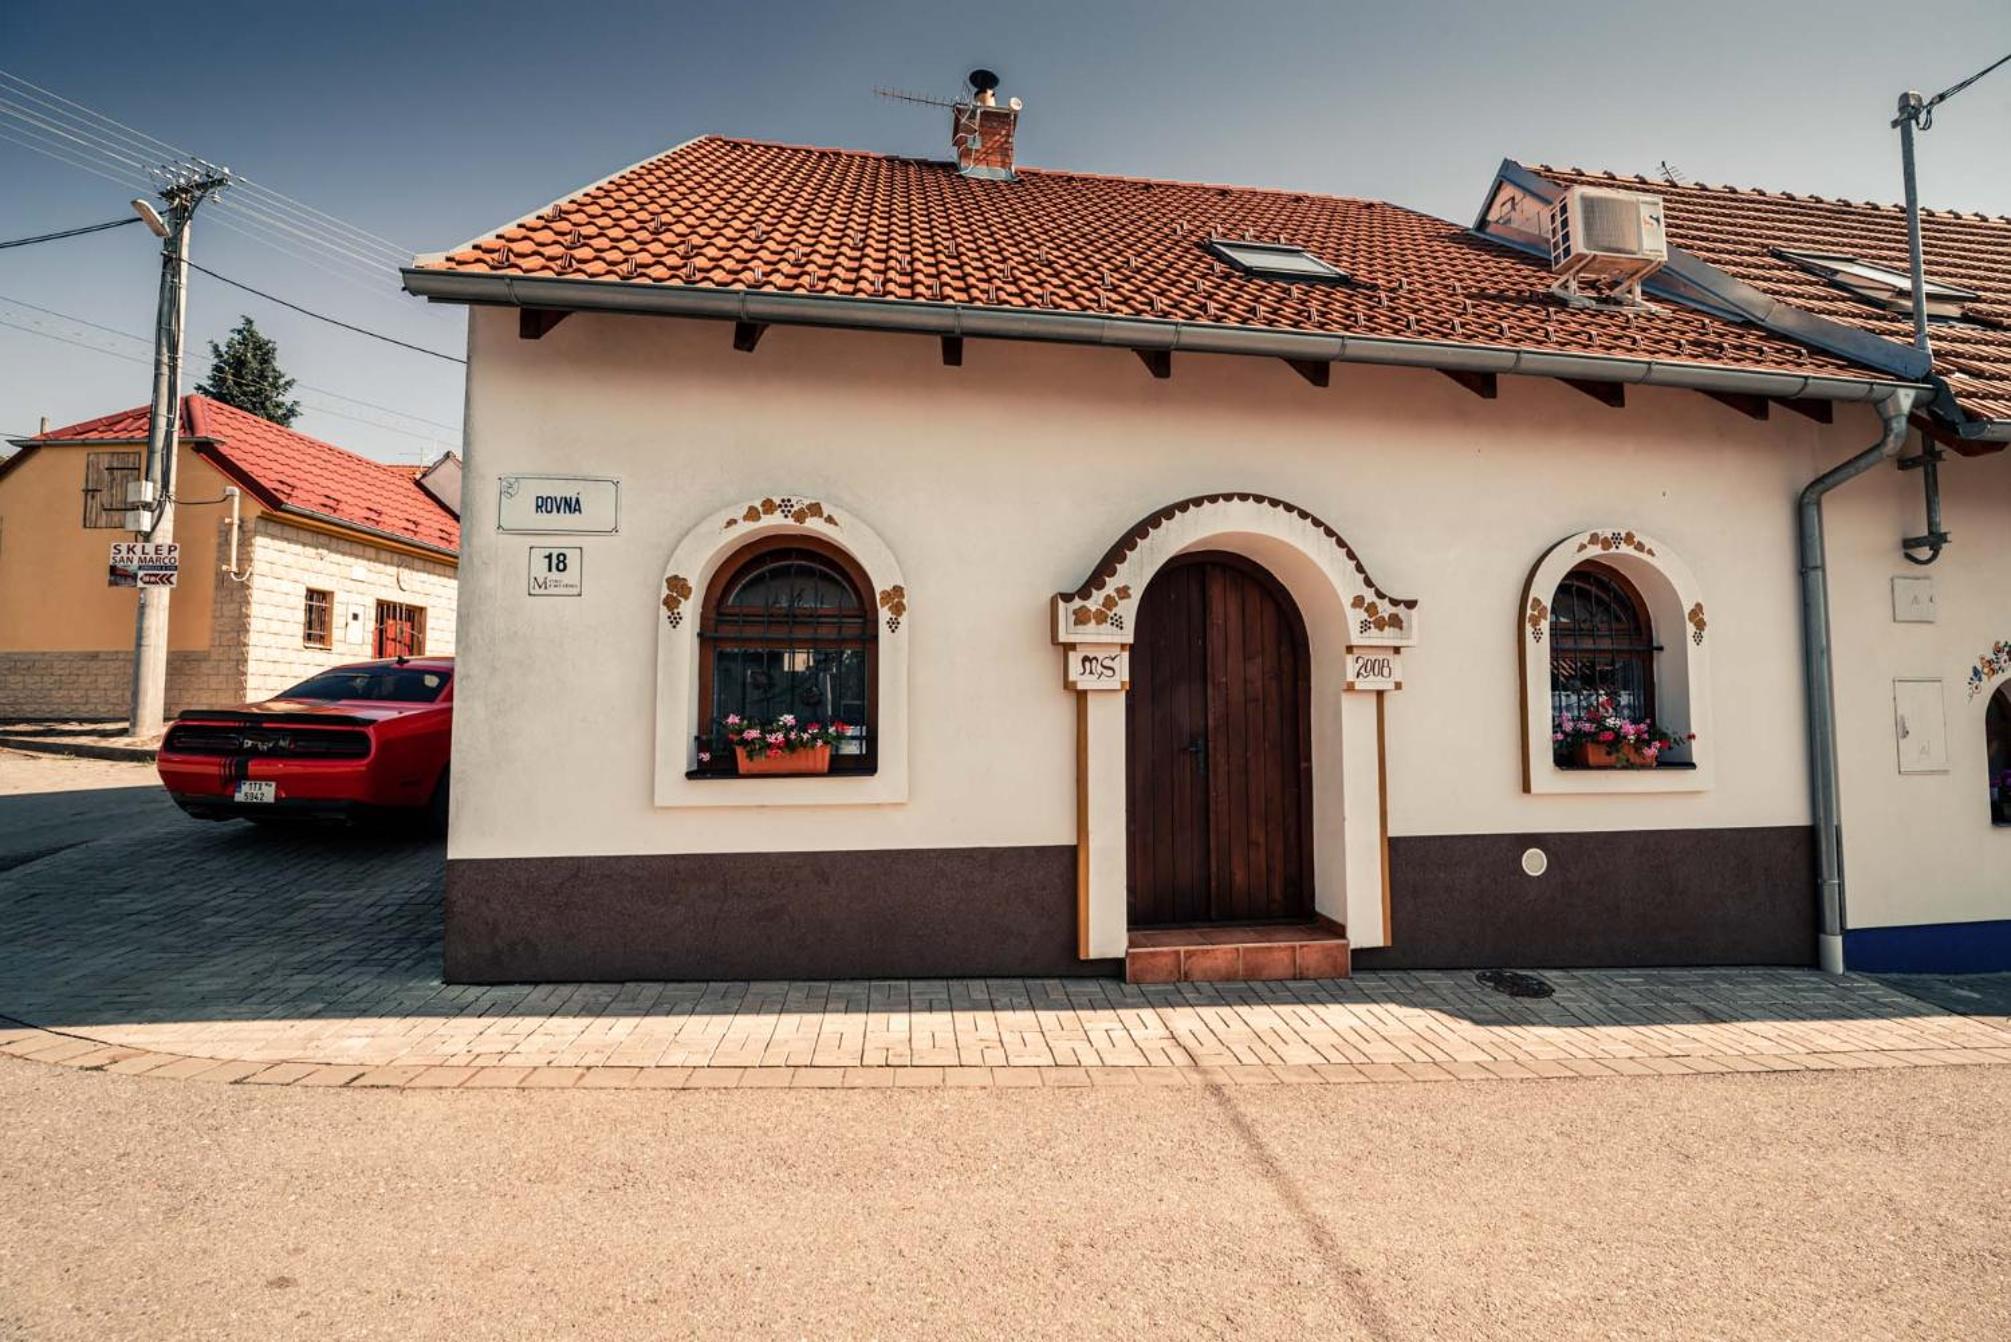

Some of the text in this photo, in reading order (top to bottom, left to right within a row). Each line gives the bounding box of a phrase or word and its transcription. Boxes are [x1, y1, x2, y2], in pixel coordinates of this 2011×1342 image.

[535, 492, 582, 514] ROVNÁ
[112, 556, 177, 565] SAN MARCO
[113, 544, 178, 556] SKLEP
[543, 552, 568, 573] 18
[1355, 656, 1392, 679] 2008
